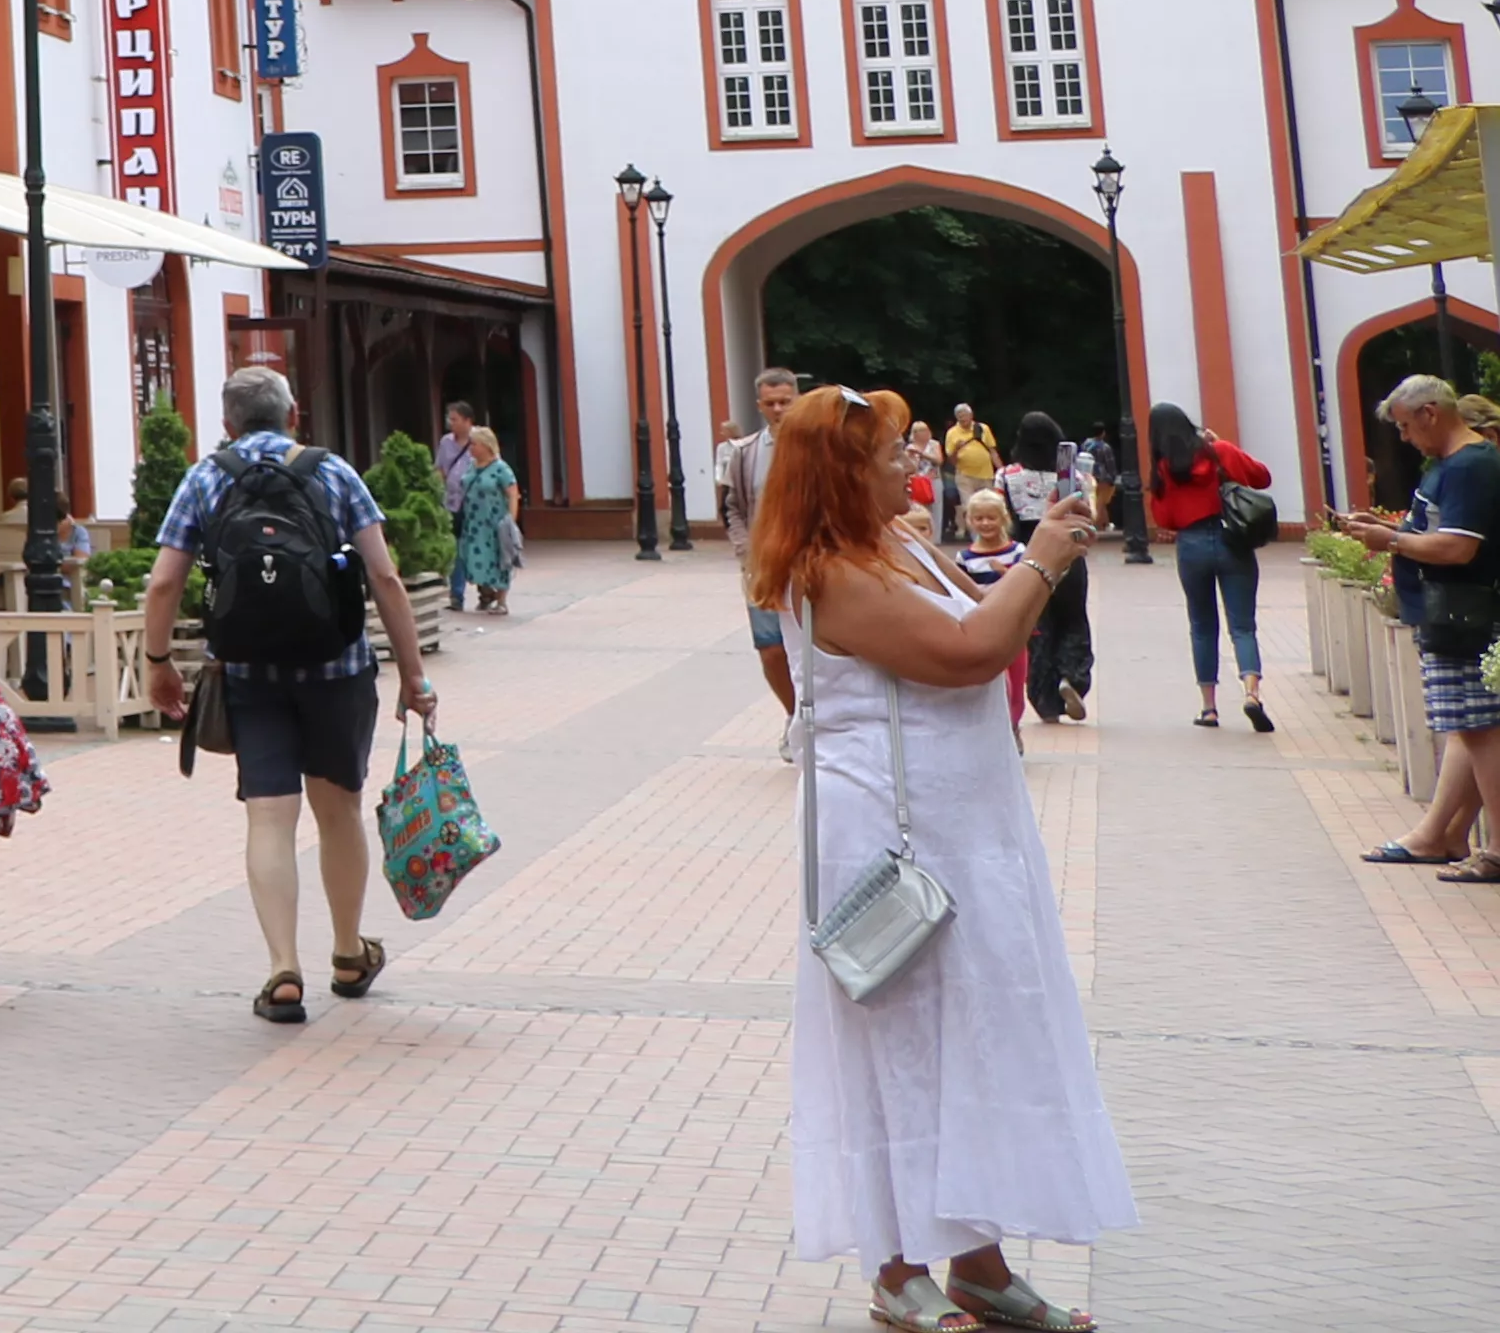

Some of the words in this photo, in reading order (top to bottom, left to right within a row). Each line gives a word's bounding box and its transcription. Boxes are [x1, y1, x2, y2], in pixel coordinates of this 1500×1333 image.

[279, 150, 301, 166] RE
[270, 210, 317, 227] ТУРЫ
[95, 249, 151, 263] PRESENTS
